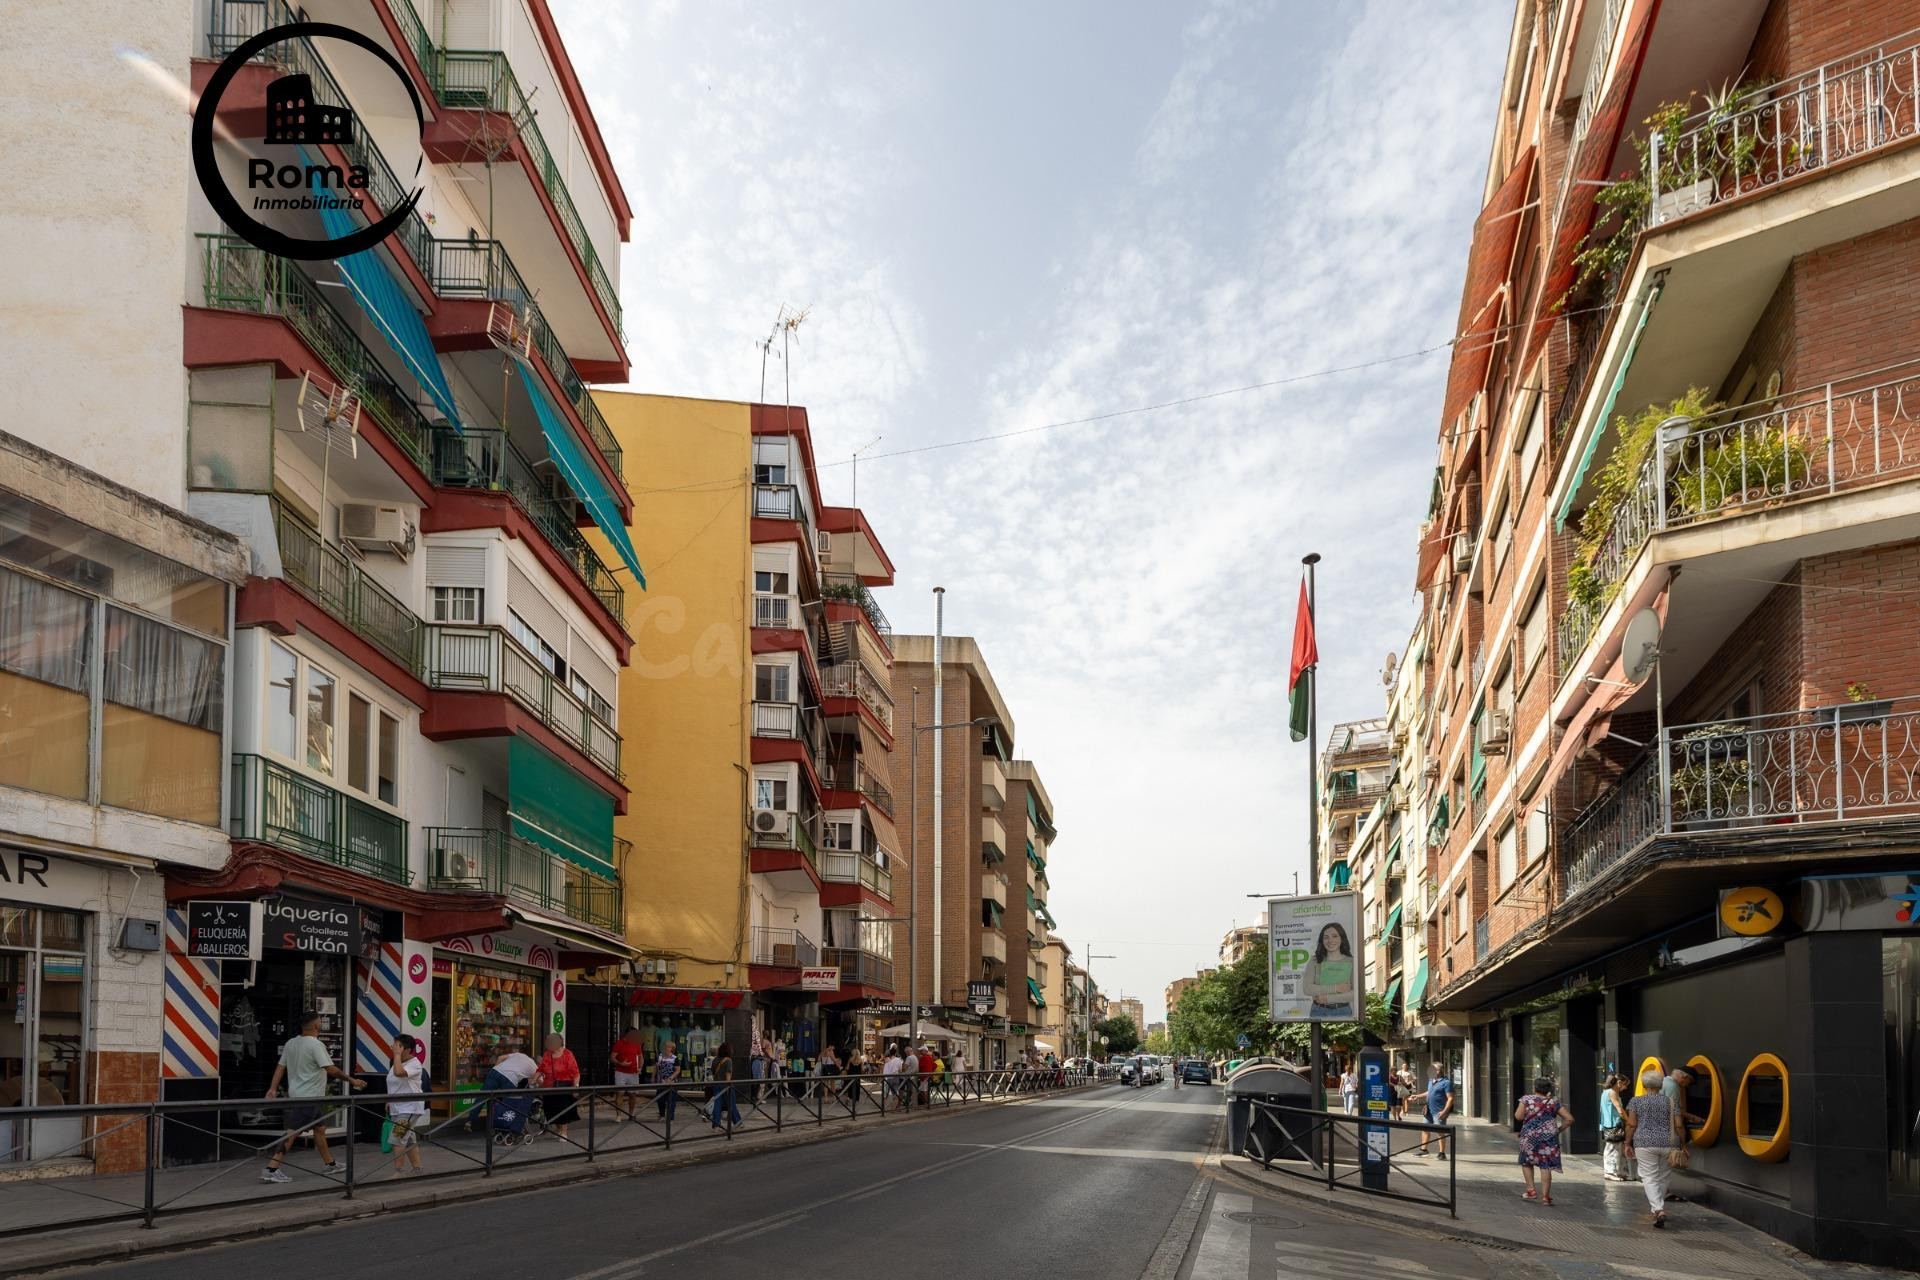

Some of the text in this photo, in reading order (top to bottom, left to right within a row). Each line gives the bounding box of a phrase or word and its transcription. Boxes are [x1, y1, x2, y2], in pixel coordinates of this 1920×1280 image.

[263, 901, 348, 924] luquería
[190, 926, 247, 940] PELUQUERÍA
[301, 925, 348, 937] Caballeros
[282, 932, 348, 953] Sultán
[1275, 938, 1290, 947] TU
[190, 944, 247, 957] CABALLEROS
[1275, 949, 1310, 971] FP
[802, 971, 837, 979] IMPACTO
[972, 984, 991, 996] ZAIDA
[629, 988, 743, 1008] IMPACTO
[1365, 1065, 1380, 1080] P
